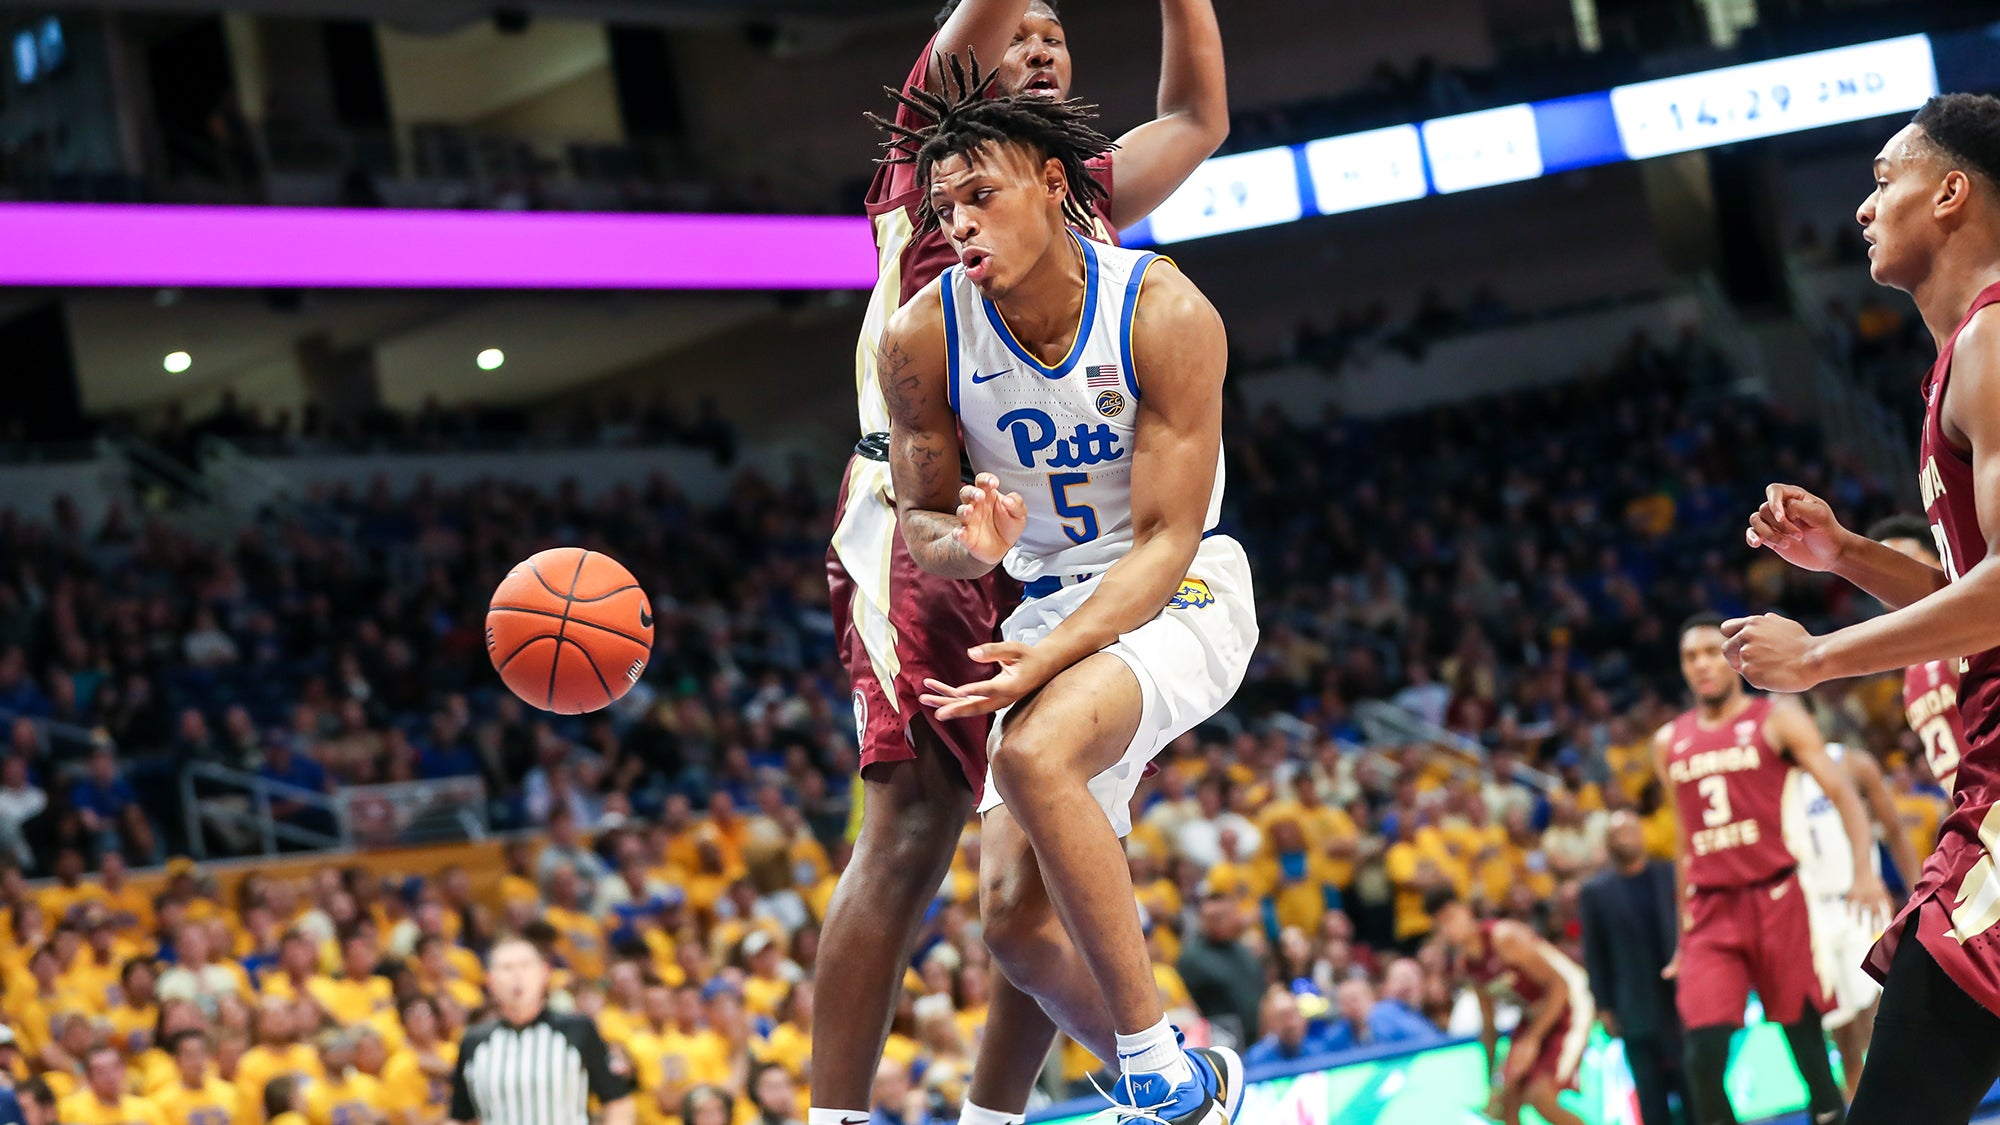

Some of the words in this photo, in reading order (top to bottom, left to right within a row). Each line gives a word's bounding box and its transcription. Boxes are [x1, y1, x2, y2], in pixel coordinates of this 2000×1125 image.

[997, 409, 1124, 468] Pitt
[1048, 472, 1099, 544] 5
[1669, 745, 1760, 783] FLORIDA
[1698, 775, 1732, 827] 3
[1692, 819, 1760, 856] STATE
